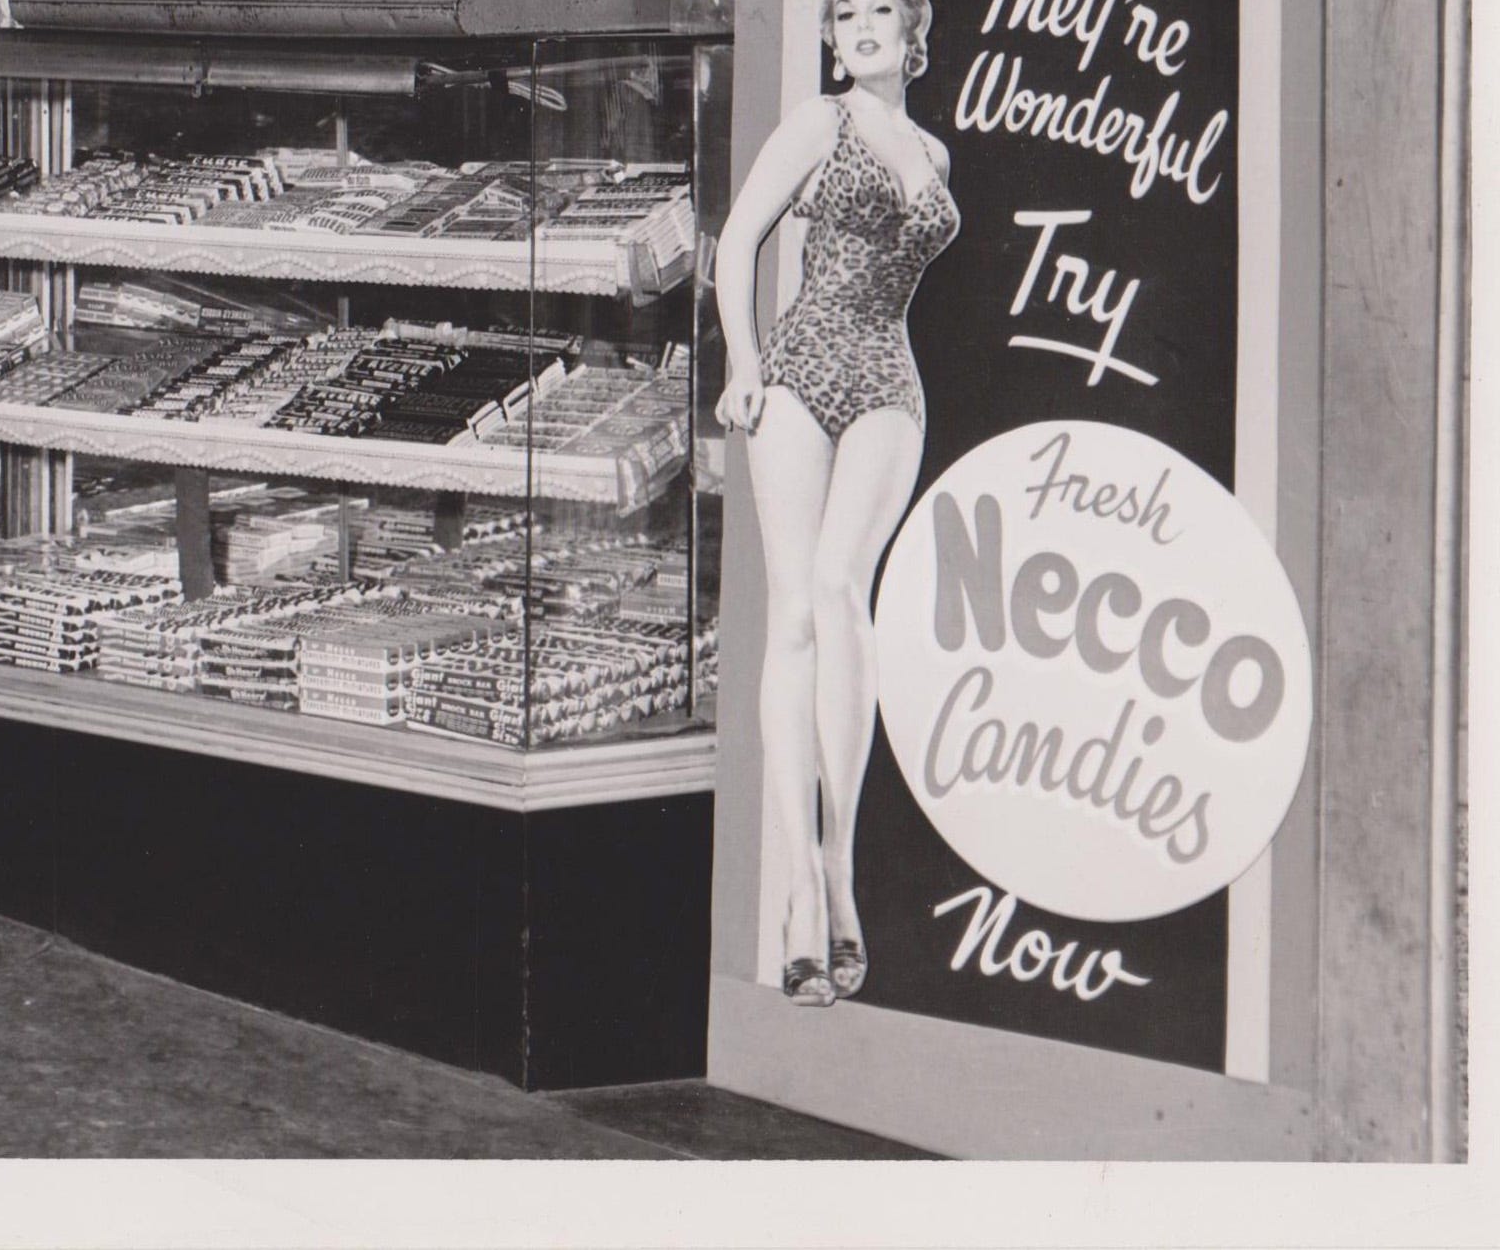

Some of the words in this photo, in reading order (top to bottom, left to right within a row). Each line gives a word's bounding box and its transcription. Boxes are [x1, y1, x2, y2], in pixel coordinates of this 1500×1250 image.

[954, 50, 1230, 205] Wonderful
[1008, 209, 1154, 387] Try
[1025, 432, 1186, 546] Fresh
[932, 491, 1286, 743] Necco
[924, 666, 1213, 865] Candies
[933, 886, 1153, 1001] Now
